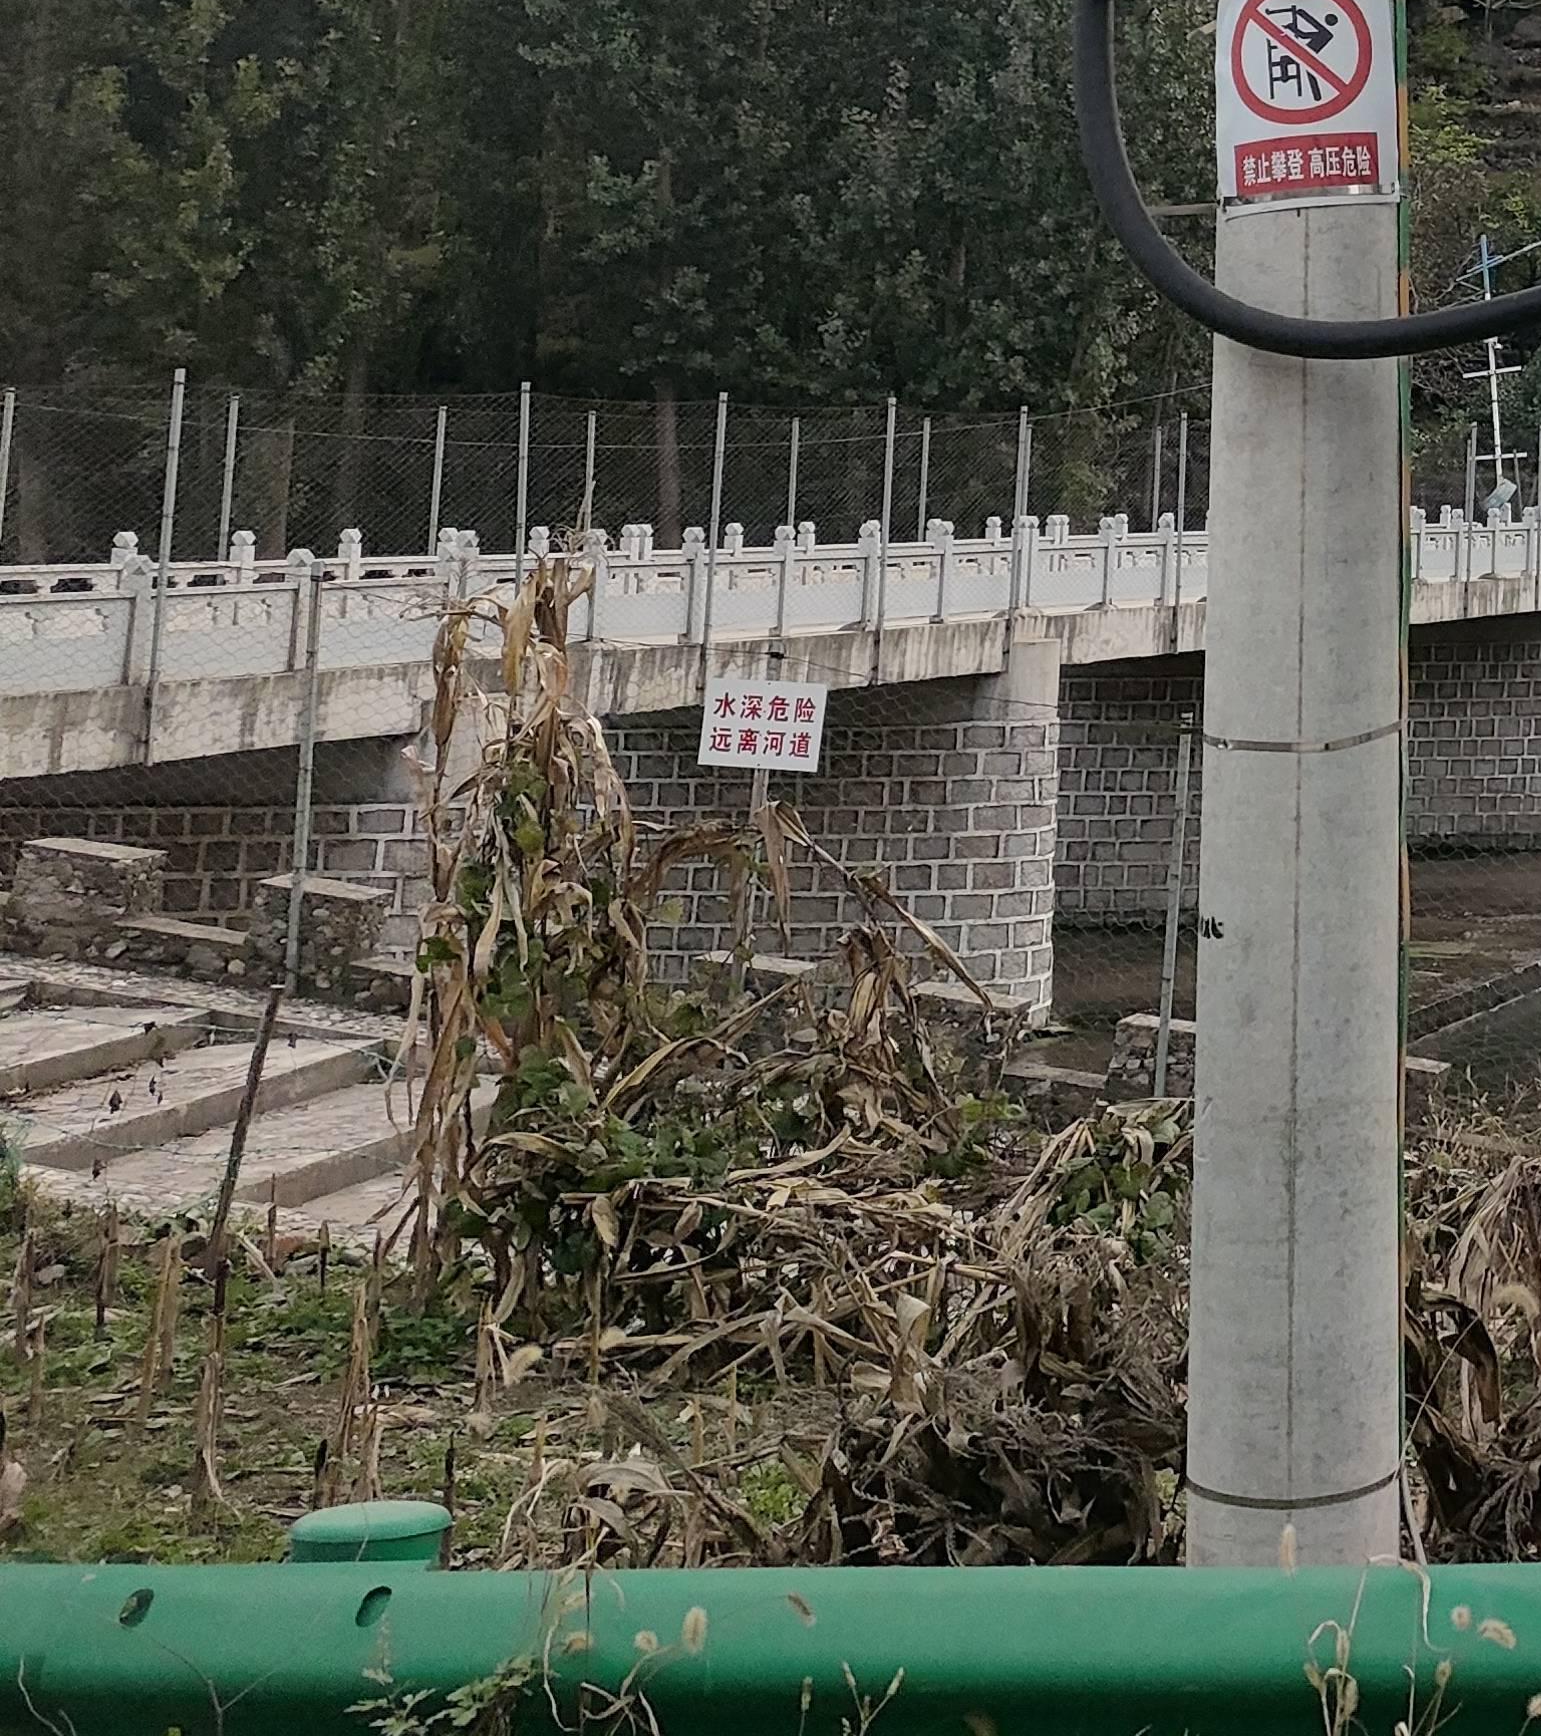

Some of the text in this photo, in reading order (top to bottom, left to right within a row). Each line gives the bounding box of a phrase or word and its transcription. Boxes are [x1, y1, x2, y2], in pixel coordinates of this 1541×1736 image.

[1243, 146, 1372, 186] 禁止攀登 高压危险
[713, 692, 816, 723] 水深危险
[709, 726, 812, 758] 远离河道
